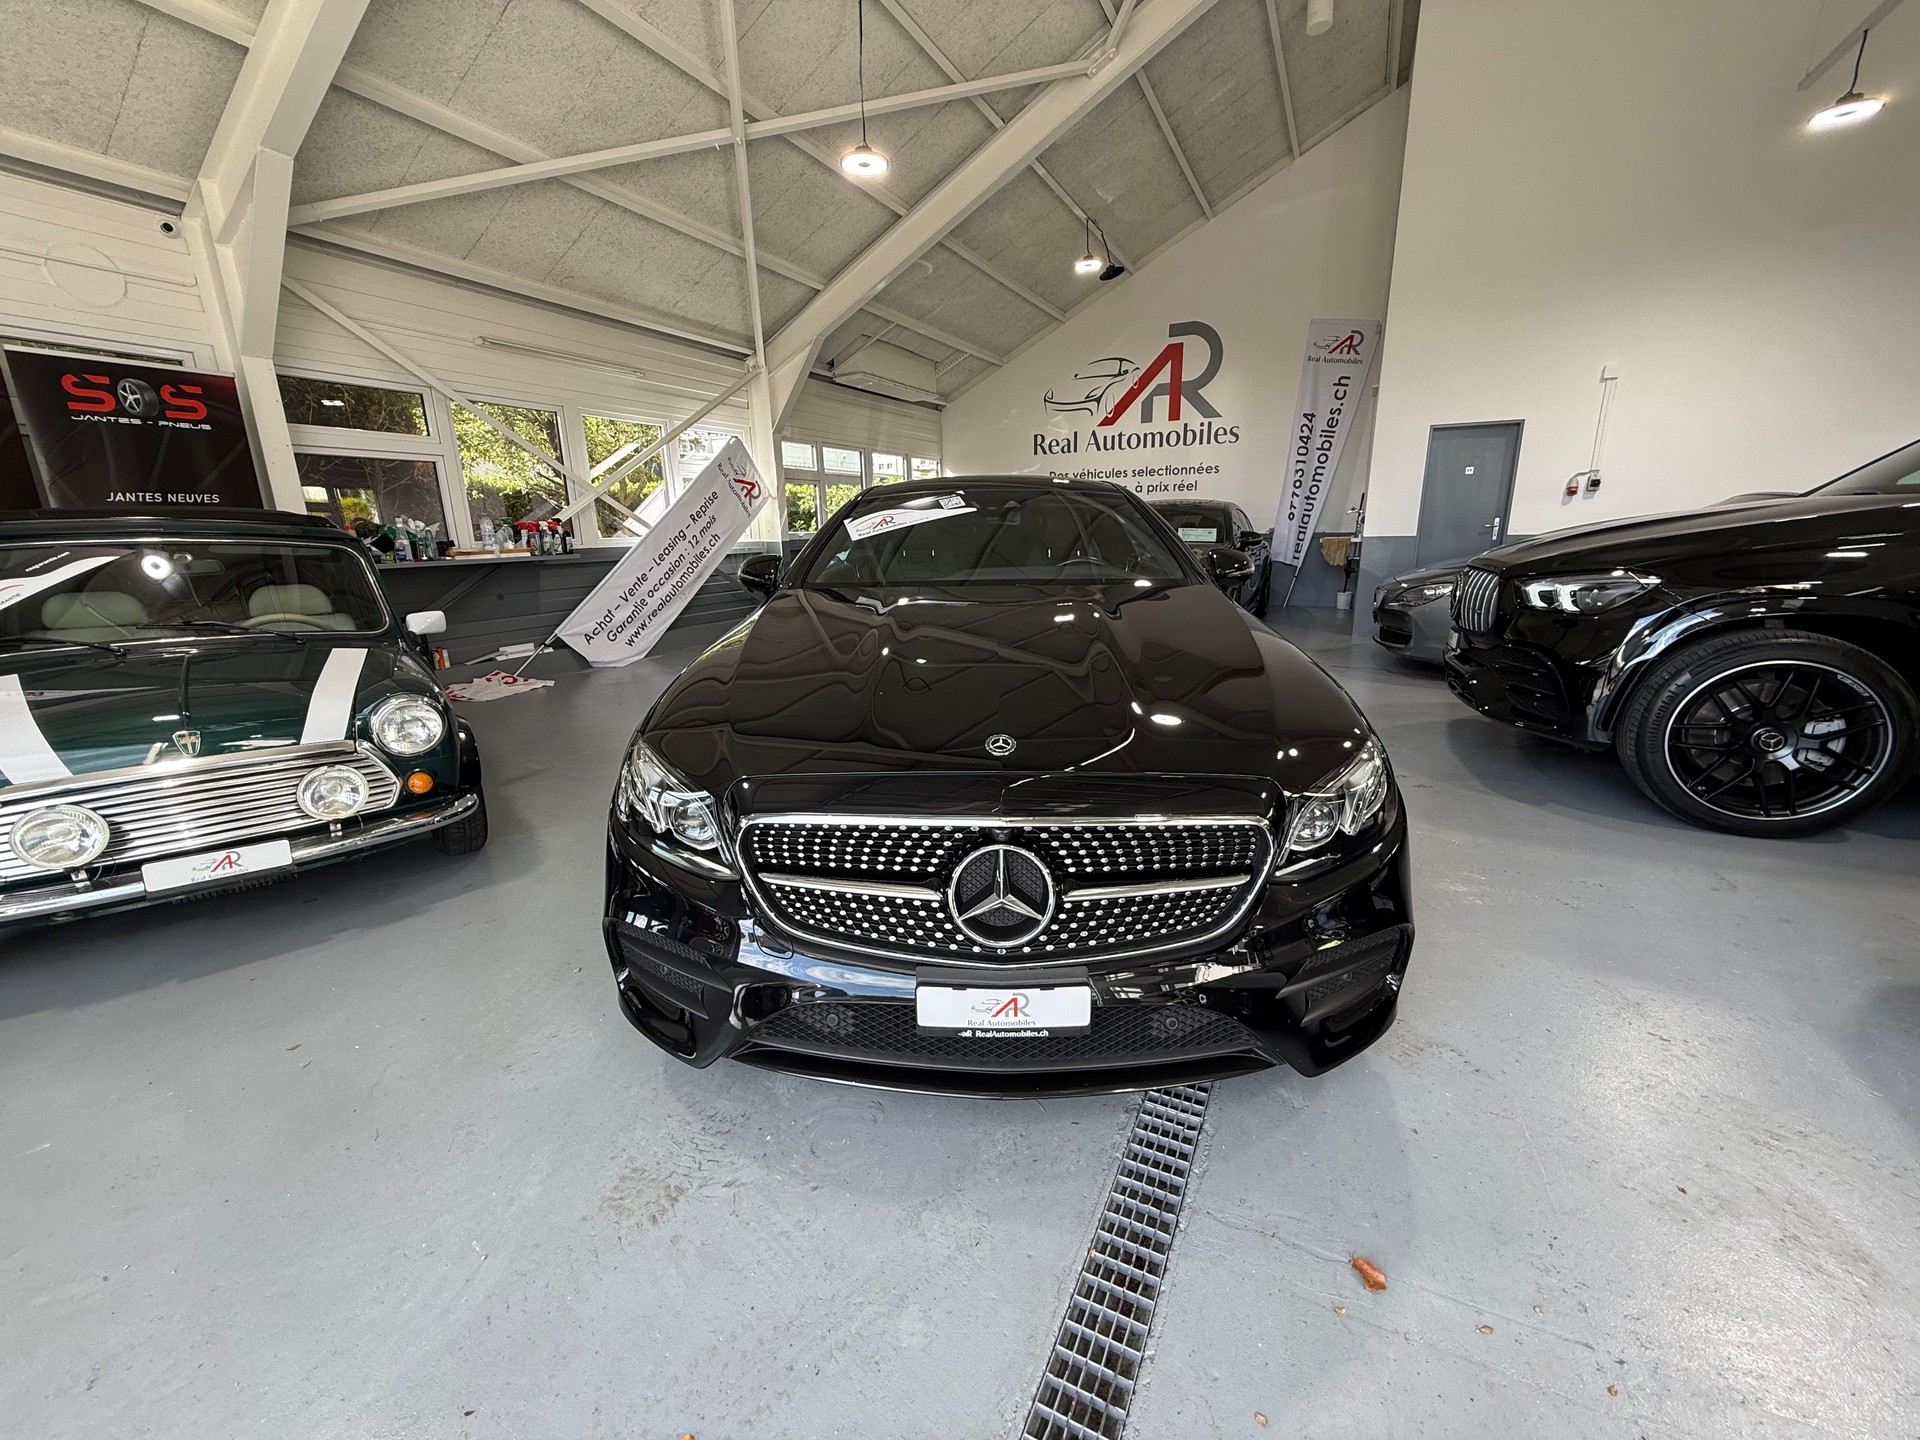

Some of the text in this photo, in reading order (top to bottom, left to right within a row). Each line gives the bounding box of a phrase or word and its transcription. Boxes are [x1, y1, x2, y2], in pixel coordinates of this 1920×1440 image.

[1307, 355, 1363, 365] Real Automobiles
[71, 414, 141, 424] JANTES
[158, 420, 212, 430] PNEUS
[1033, 421, 1240, 455] Real Automobiles
[1073, 468, 1128, 480] véhicules
[1131, 462, 1219, 478] selectionnées
[1292, 375, 1351, 560] realautomobiles.ch
[717, 461, 751, 518] Real Automobiles
[1135, 482, 1143, 493] à
[1147, 482, 1169, 495] prix
[1173, 480, 1197, 492] réel
[107, 492, 220, 503] JANTES NEUVES
[583, 607, 616, 645] Achat
[620, 569, 649, 603] Vente
[653, 527, 687, 568] Leasing
[690, 490, 719, 526] Reprise
[606, 598, 649, 643] Garantie
[647, 554, 686, 599] occasion
[688, 534, 699, 549] 12
[698, 514, 717, 538] mois
[625, 532, 721, 648] www.realautomobiles.ch
[208, 867, 249, 880] Automobiles
[986, 1019, 1036, 1027] Automobiles
[975, 1029, 1049, 1038] RealAutomobiles.ch
